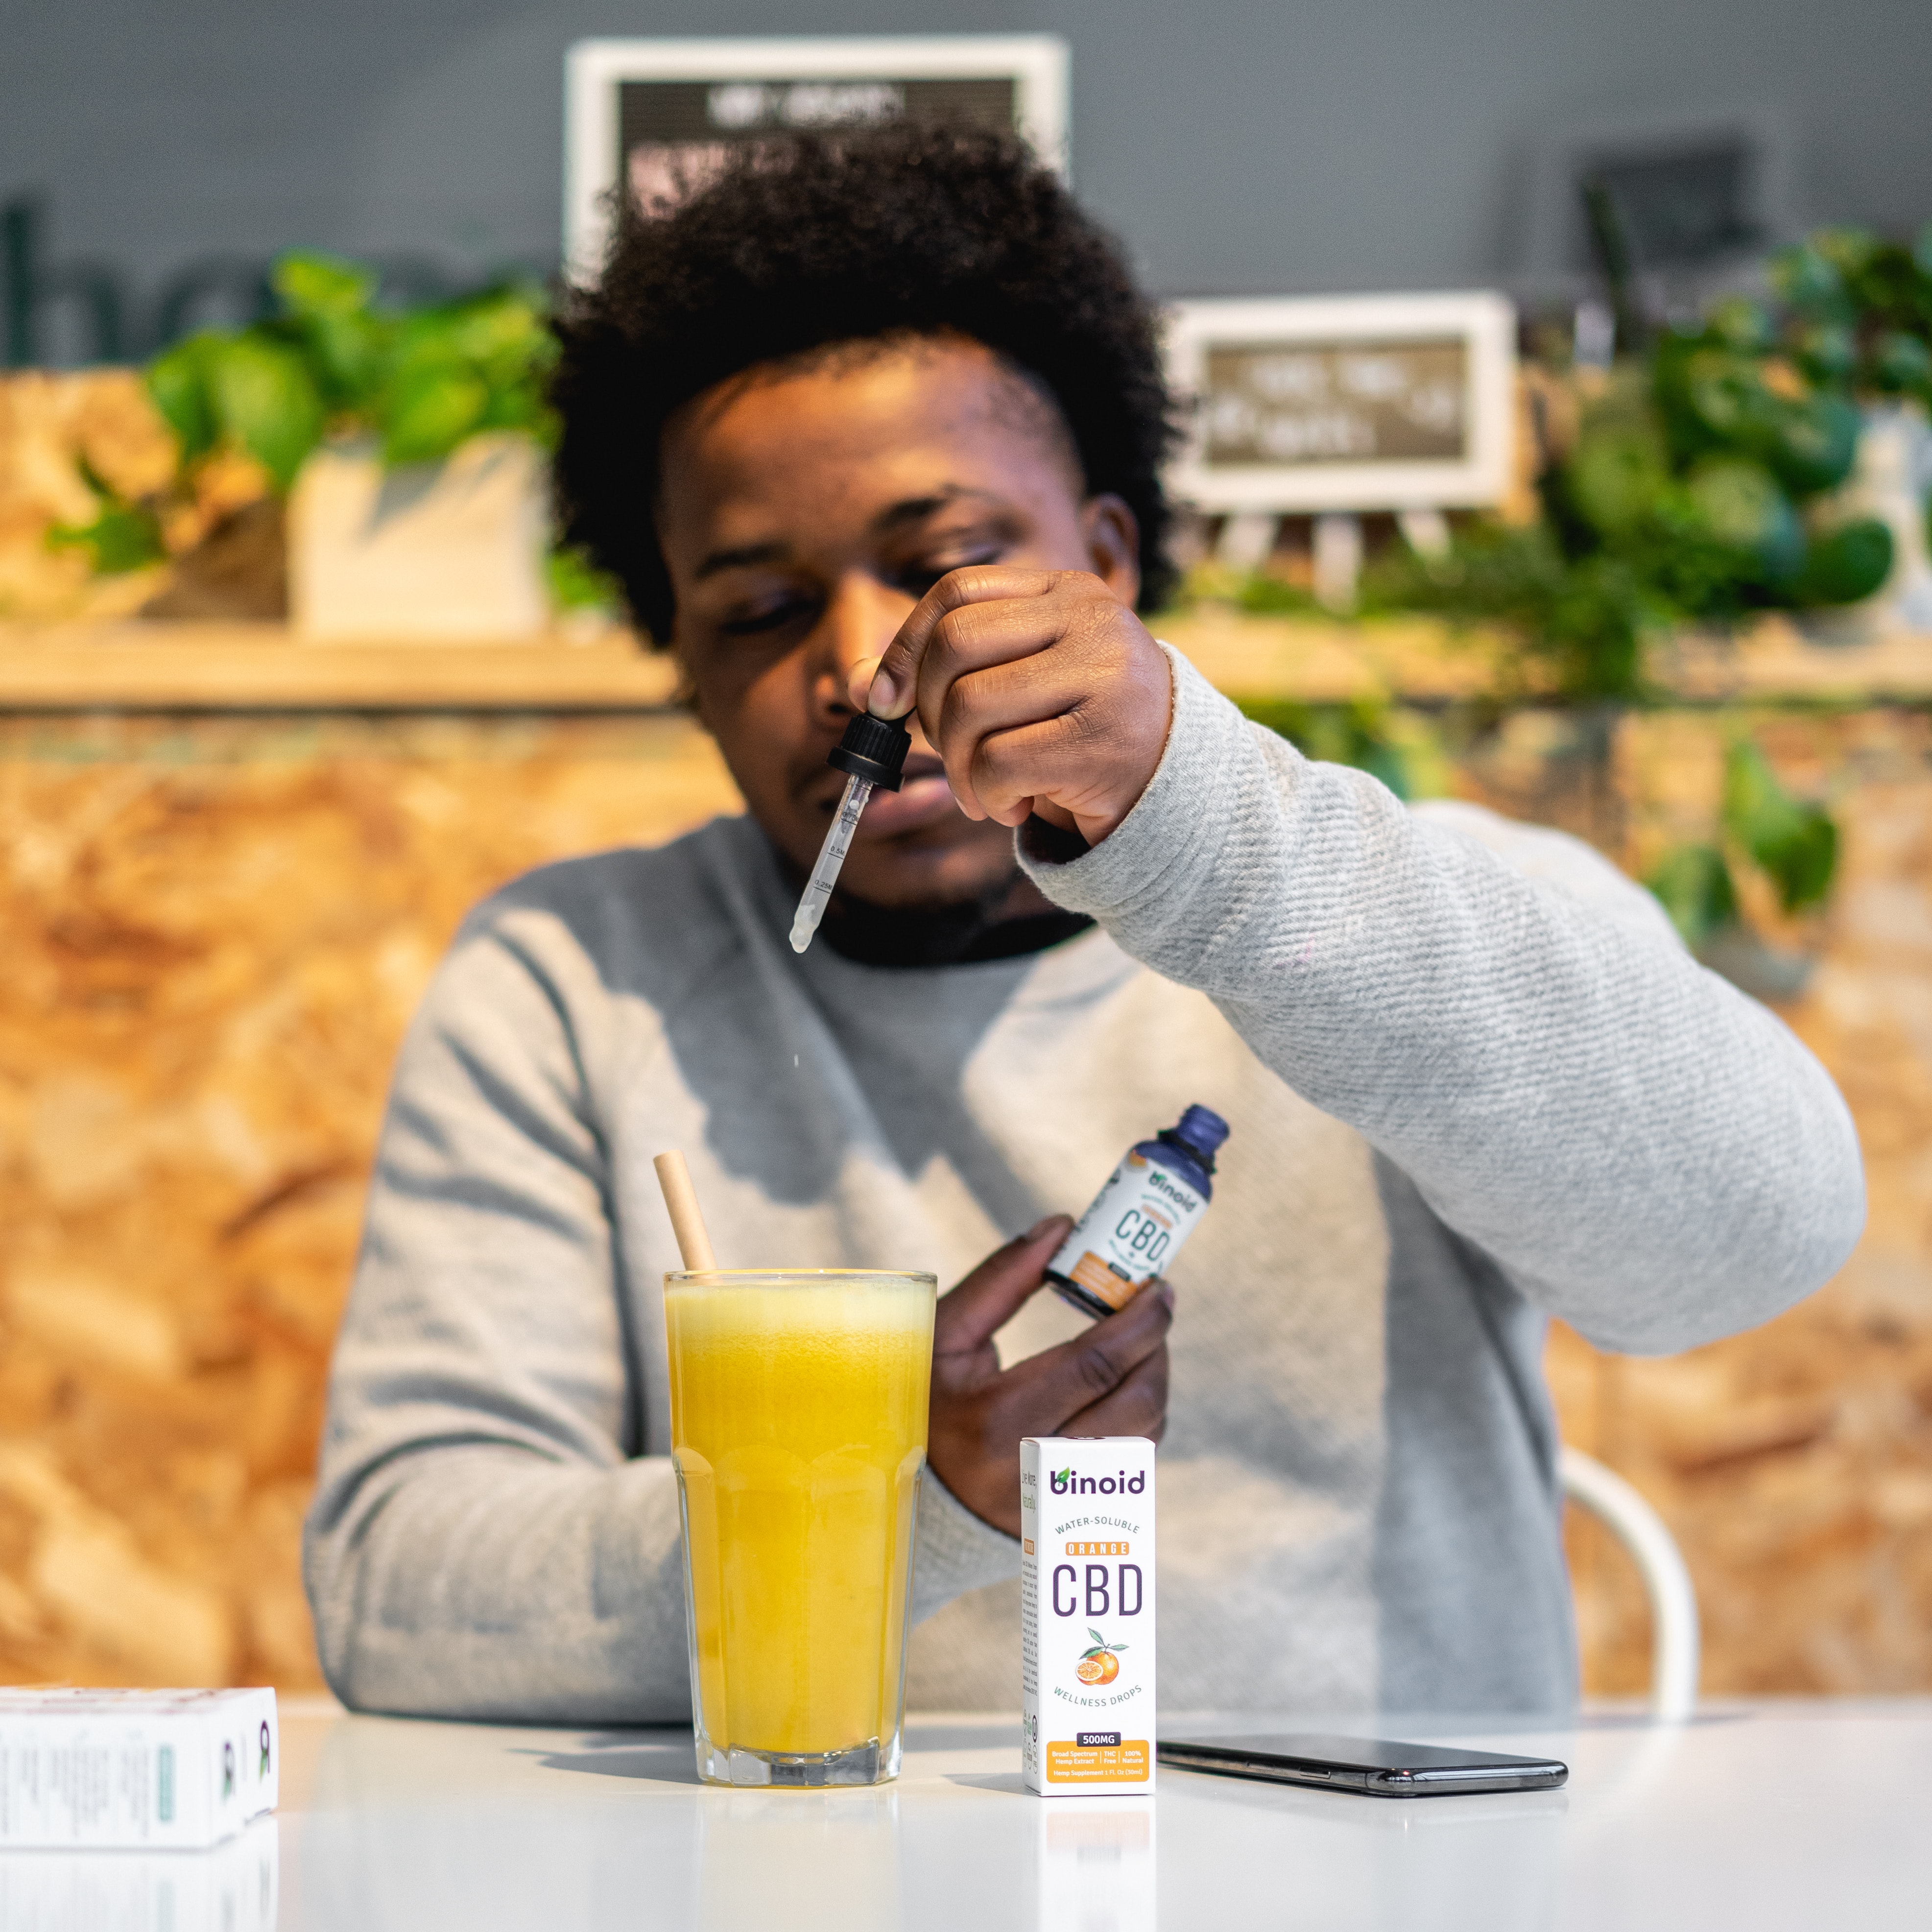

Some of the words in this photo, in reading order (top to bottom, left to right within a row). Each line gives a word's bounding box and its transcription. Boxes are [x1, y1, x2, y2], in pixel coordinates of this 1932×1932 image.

[843, 812, 859, 822] 0.75M
[831, 846, 845, 856] 0.5M
[815, 880, 833, 890] 0.25M
[1149, 1171, 1197, 1213] binoid
[1115, 1209, 1170, 1262] CBD
[1050, 1470, 1145, 1495] binoid
[1055, 1516, 1140, 1534] WATER-SOLUBLE
[1068, 1543, 1126, 1554] ORANGE
[1053, 1564, 1142, 1617] CBD
[1054, 1686, 1107, 1707] WELLNESS
[1110, 1685, 1142, 1705] DROPS
[1083, 1735, 1115, 1744] 500MG
